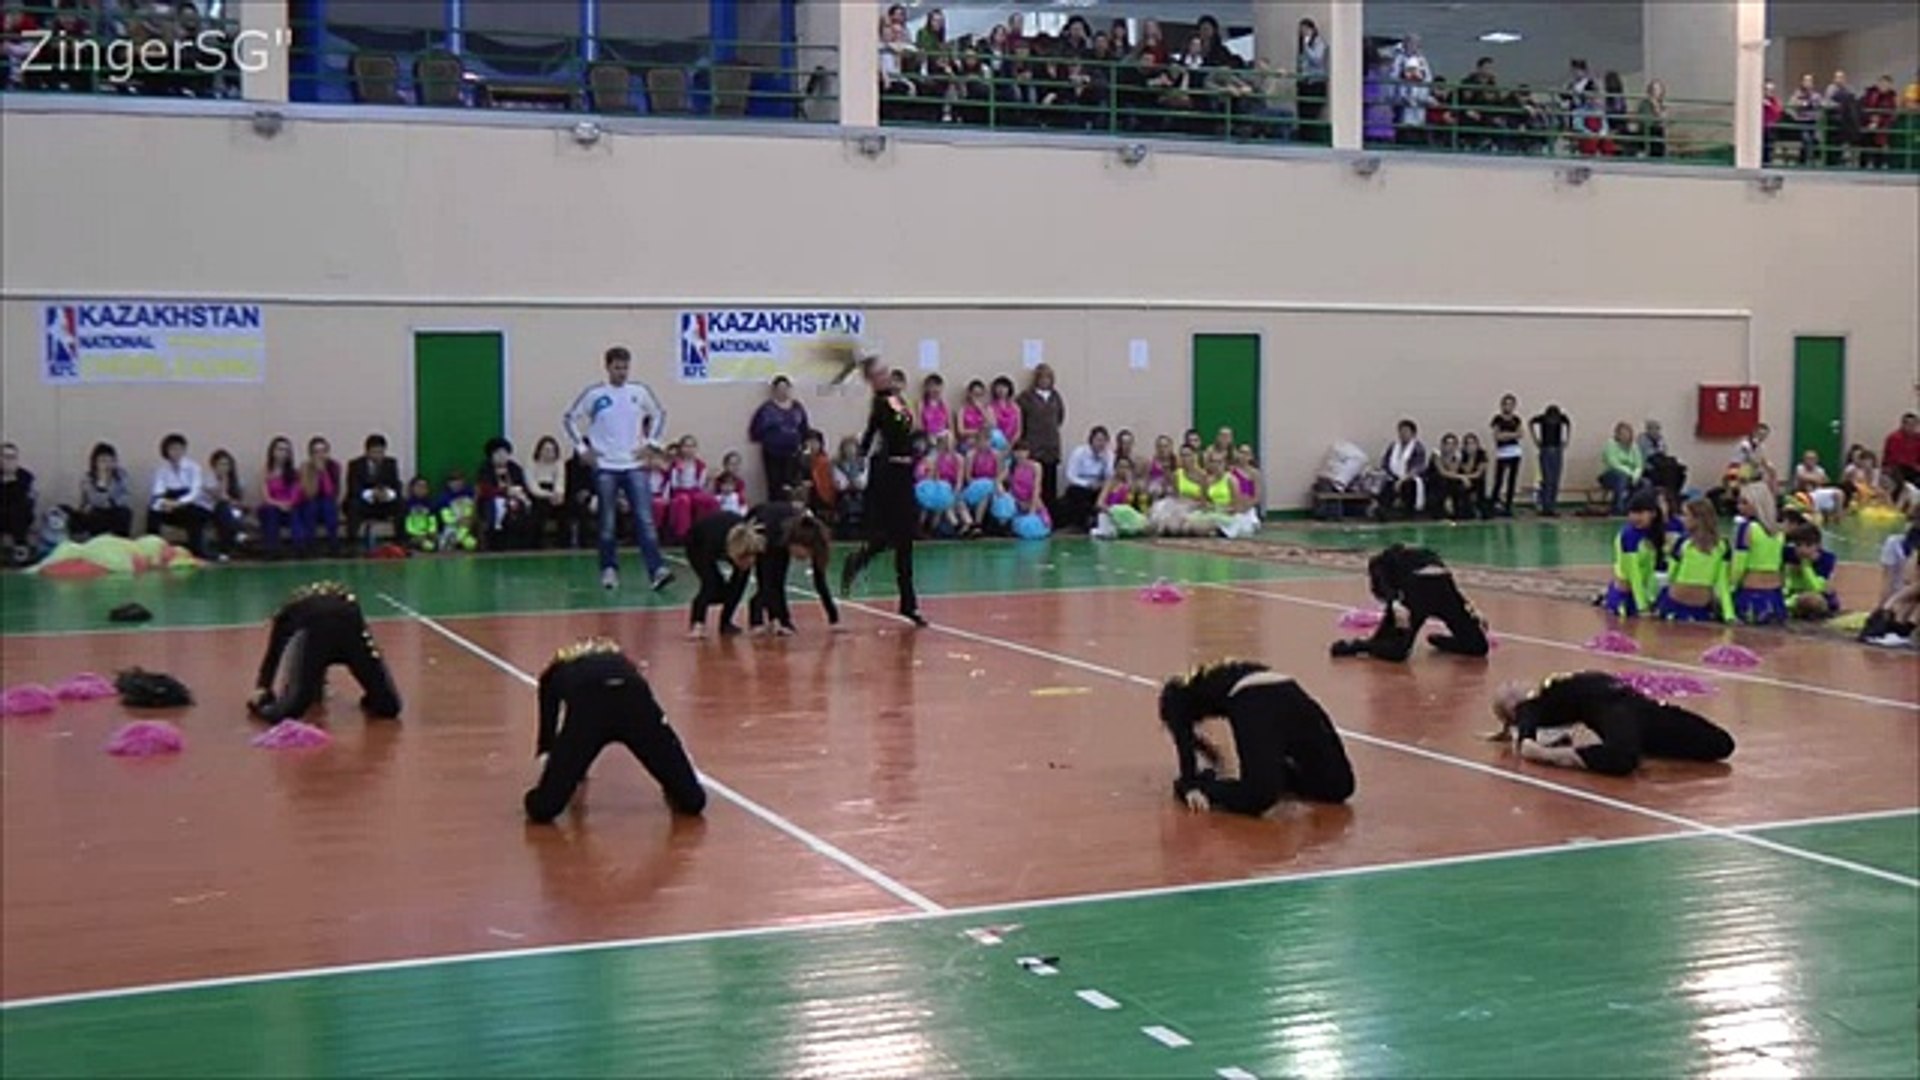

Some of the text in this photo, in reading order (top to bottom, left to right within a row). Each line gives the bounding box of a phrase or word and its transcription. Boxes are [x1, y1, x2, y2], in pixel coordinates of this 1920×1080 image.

[78, 305, 260, 328] KAZAKHSTAN
[708, 311, 860, 333] KAZAKHSTAN
[79, 335, 155, 349] NATIONAL
[710, 339, 771, 353] NATIONAL
